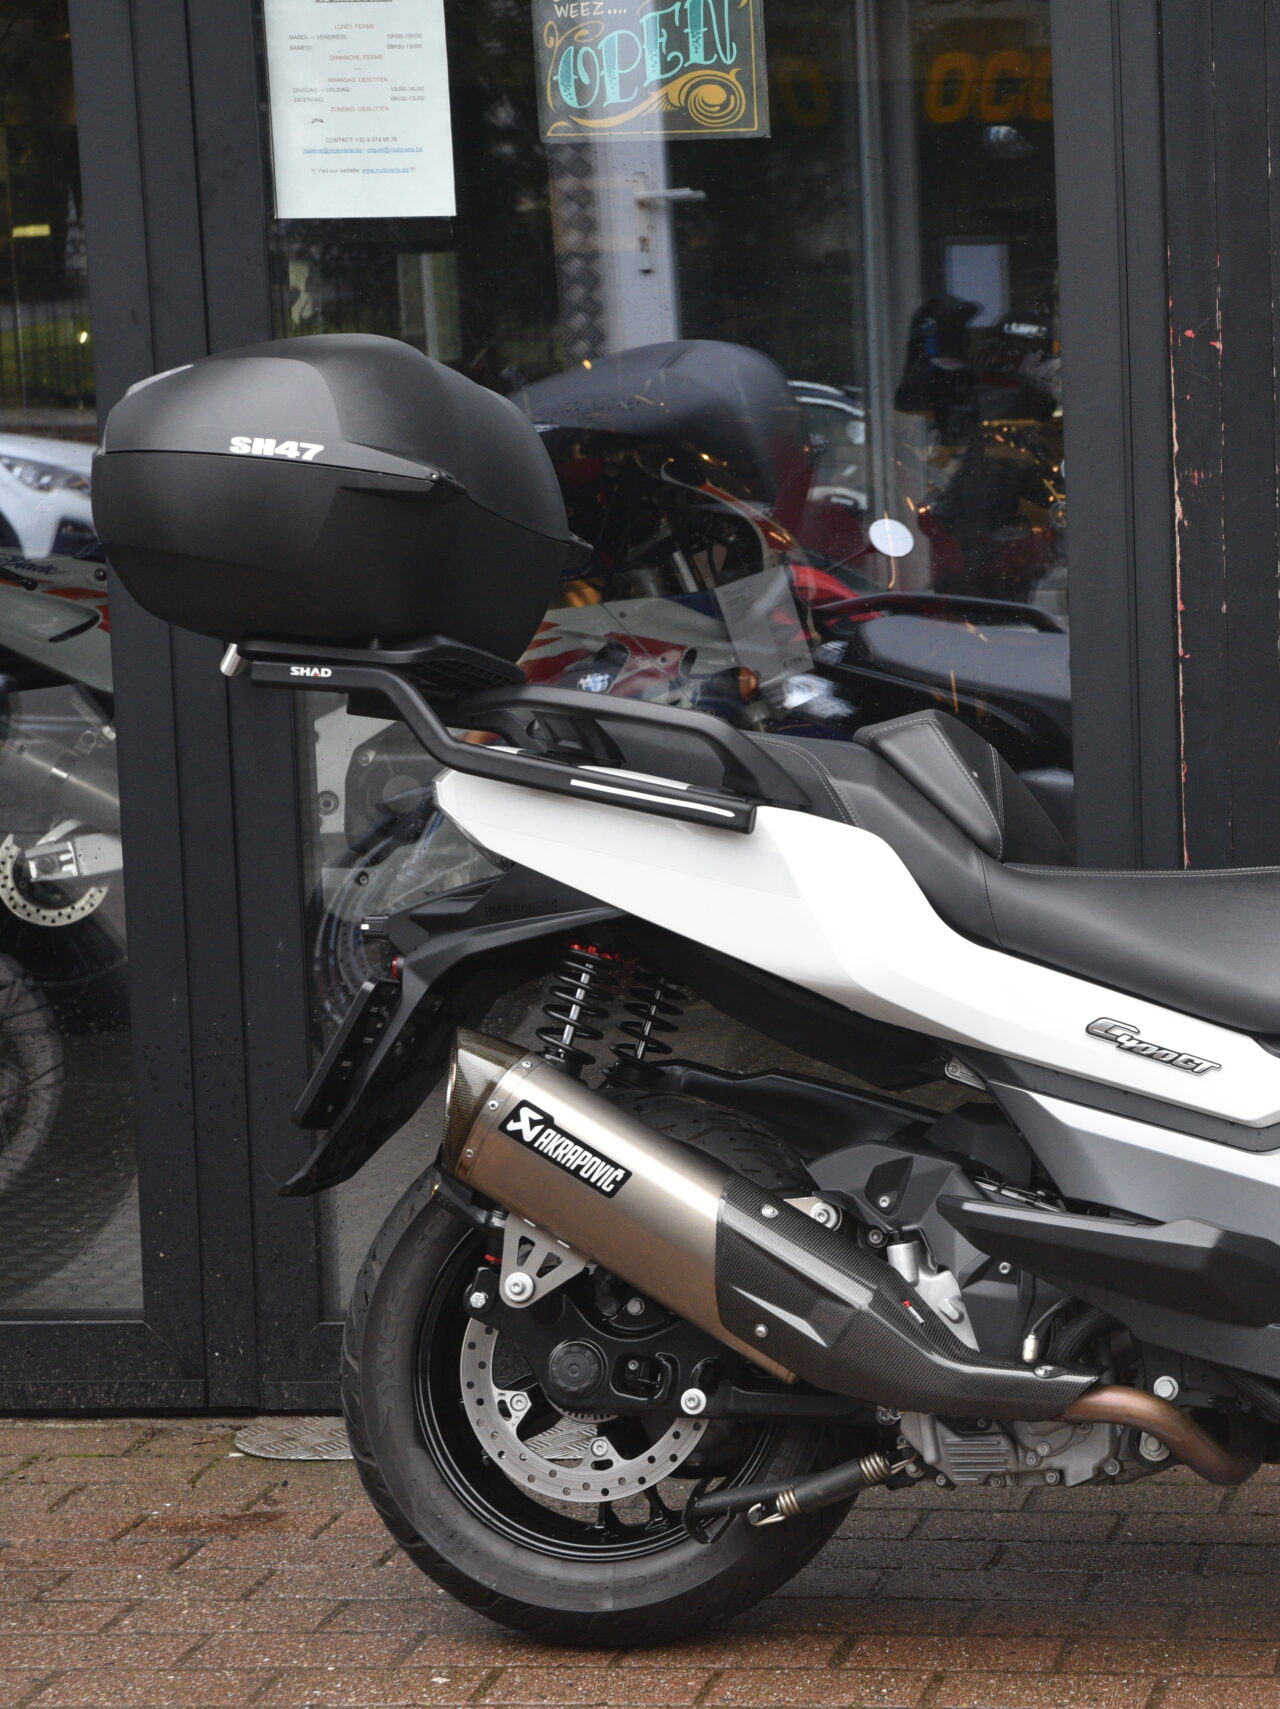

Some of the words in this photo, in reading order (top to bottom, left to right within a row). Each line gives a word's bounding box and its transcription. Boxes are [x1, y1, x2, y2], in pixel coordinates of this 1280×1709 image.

[553, 0, 736, 109] OPEN
[229, 436, 325, 461] SH47
[290, 666, 332, 678] SHAD
[533, 1128, 626, 1193] AKRAPOVIČ
